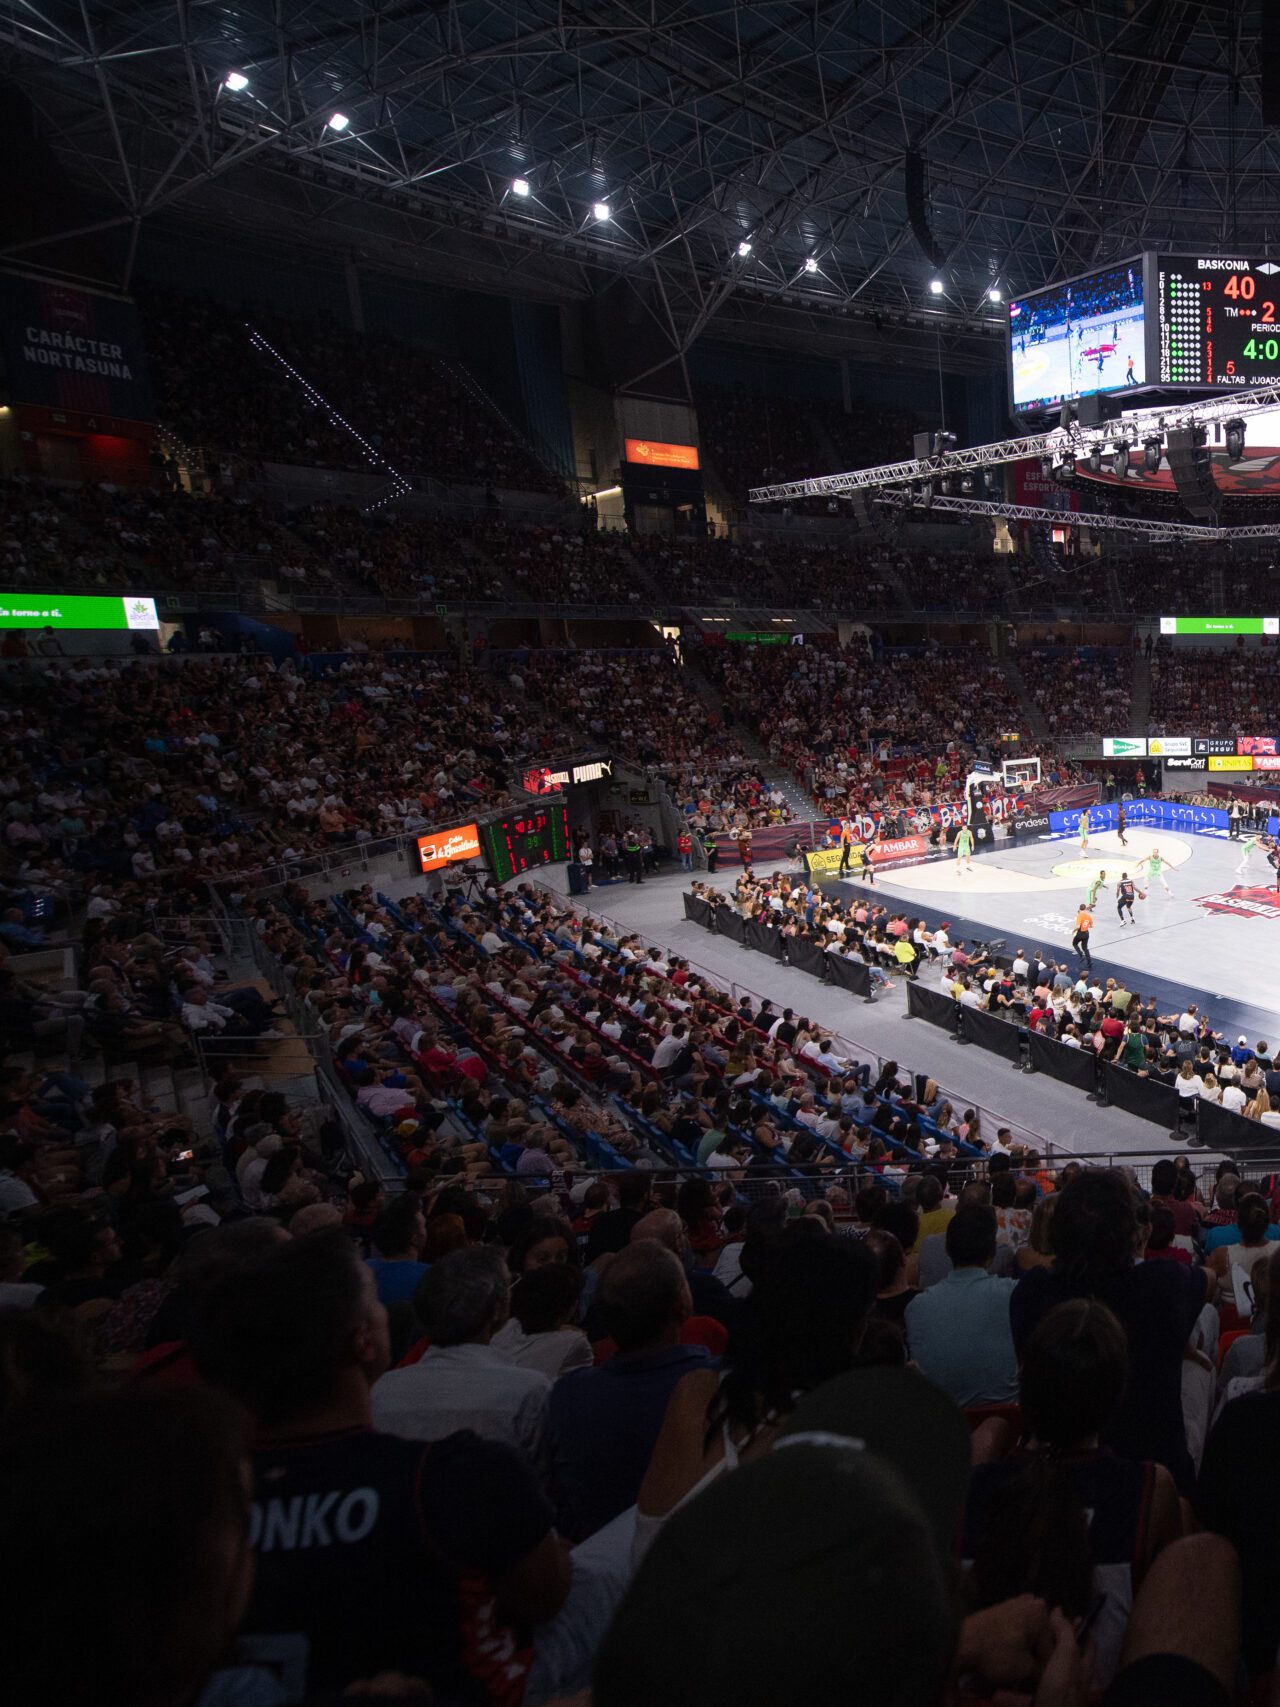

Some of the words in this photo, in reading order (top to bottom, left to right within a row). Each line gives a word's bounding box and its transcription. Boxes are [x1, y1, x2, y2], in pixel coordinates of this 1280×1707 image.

[1197, 259, 1250, 271] BASKONIA
[1159, 272, 1165, 280] E
[1202, 282, 1212, 290] 13
[1223, 275, 1255, 300] 40
[1224, 307, 1238, 317] TM
[1261, 301, 1275, 322] 2
[25, 327, 123, 360] CARÁCTER
[1243, 338, 1279, 360] 4:0
[23, 345, 132, 381] NORTASUNA
[1226, 361, 1235, 374] 5
[1217, 376, 1246, 384] FALTAS
[12, 608, 40, 618] torno
[572, 762, 604, 785] PUMA
[1015, 816, 1049, 830] endesa
[883, 840, 919, 853] AMBAR
